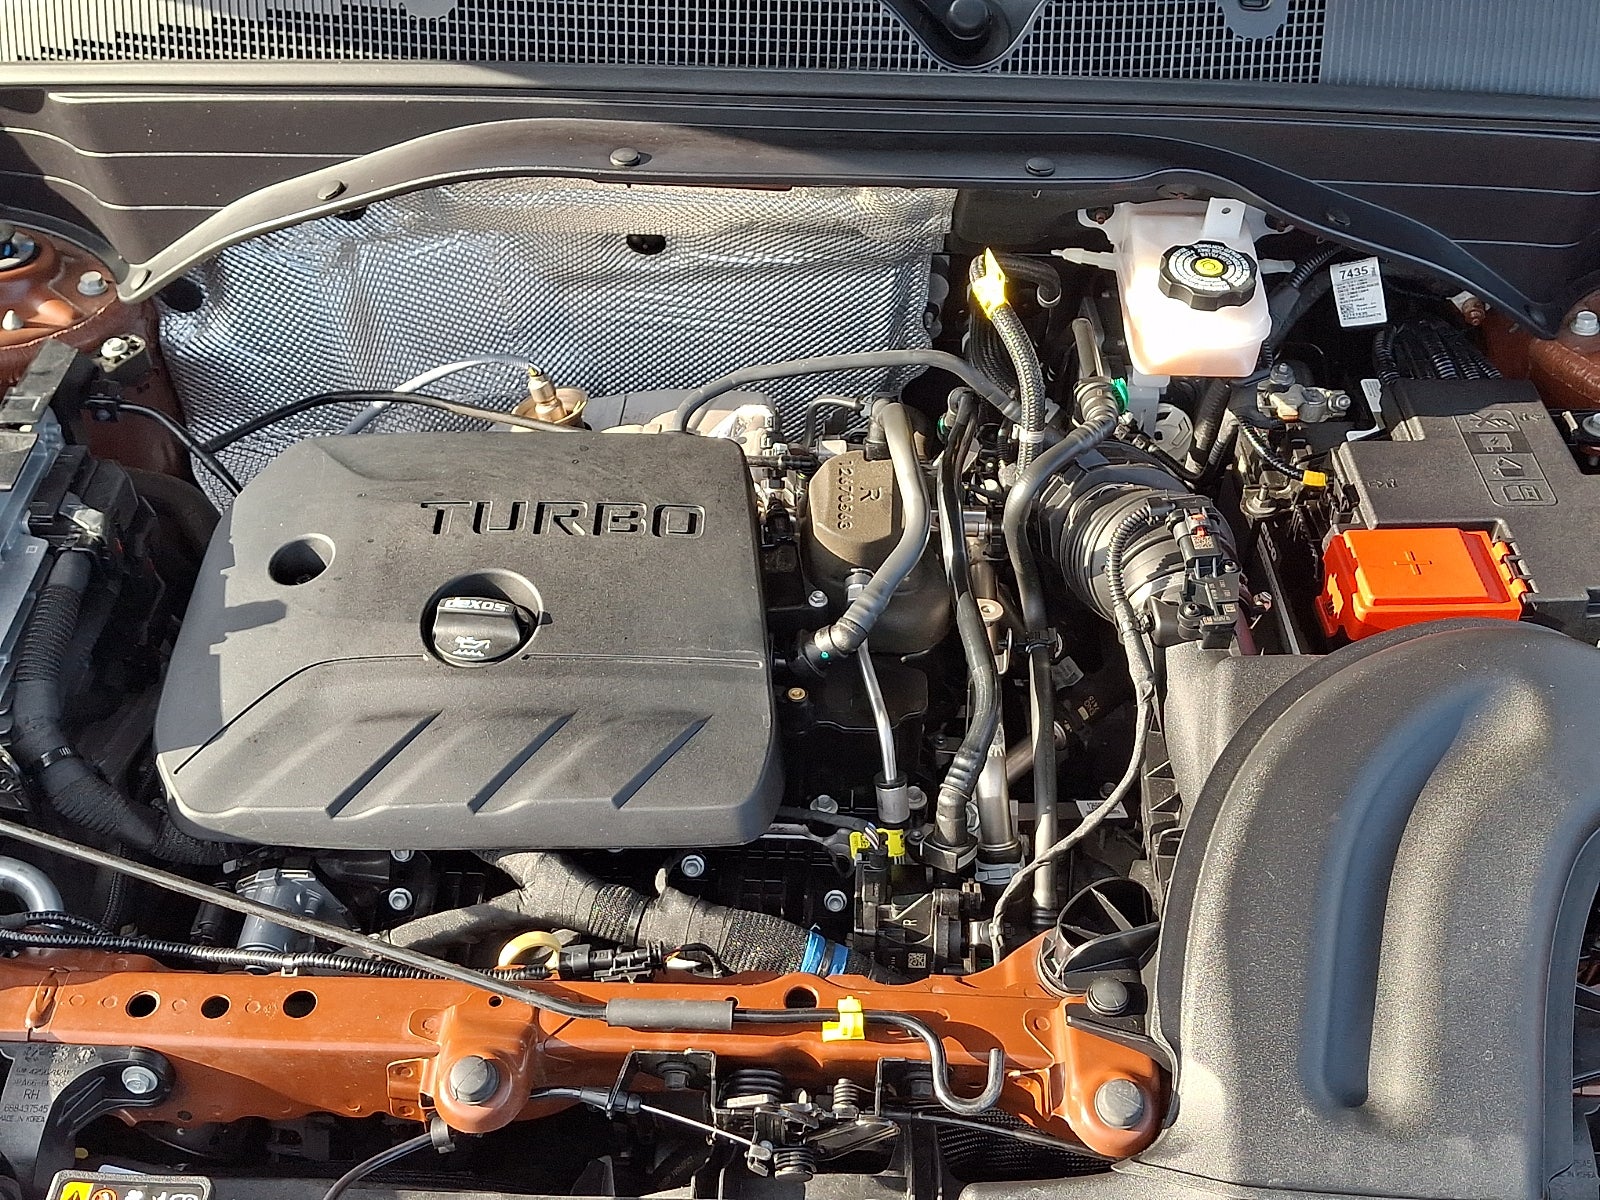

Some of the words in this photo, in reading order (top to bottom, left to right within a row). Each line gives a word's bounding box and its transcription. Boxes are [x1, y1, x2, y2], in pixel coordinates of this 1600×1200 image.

[1340, 266, 1369, 279] 7435
[860, 486, 881, 502] R
[420, 500, 706, 540] TURBO
[902, 919, 918, 927] R
[23, 1088, 41, 1101] RH
